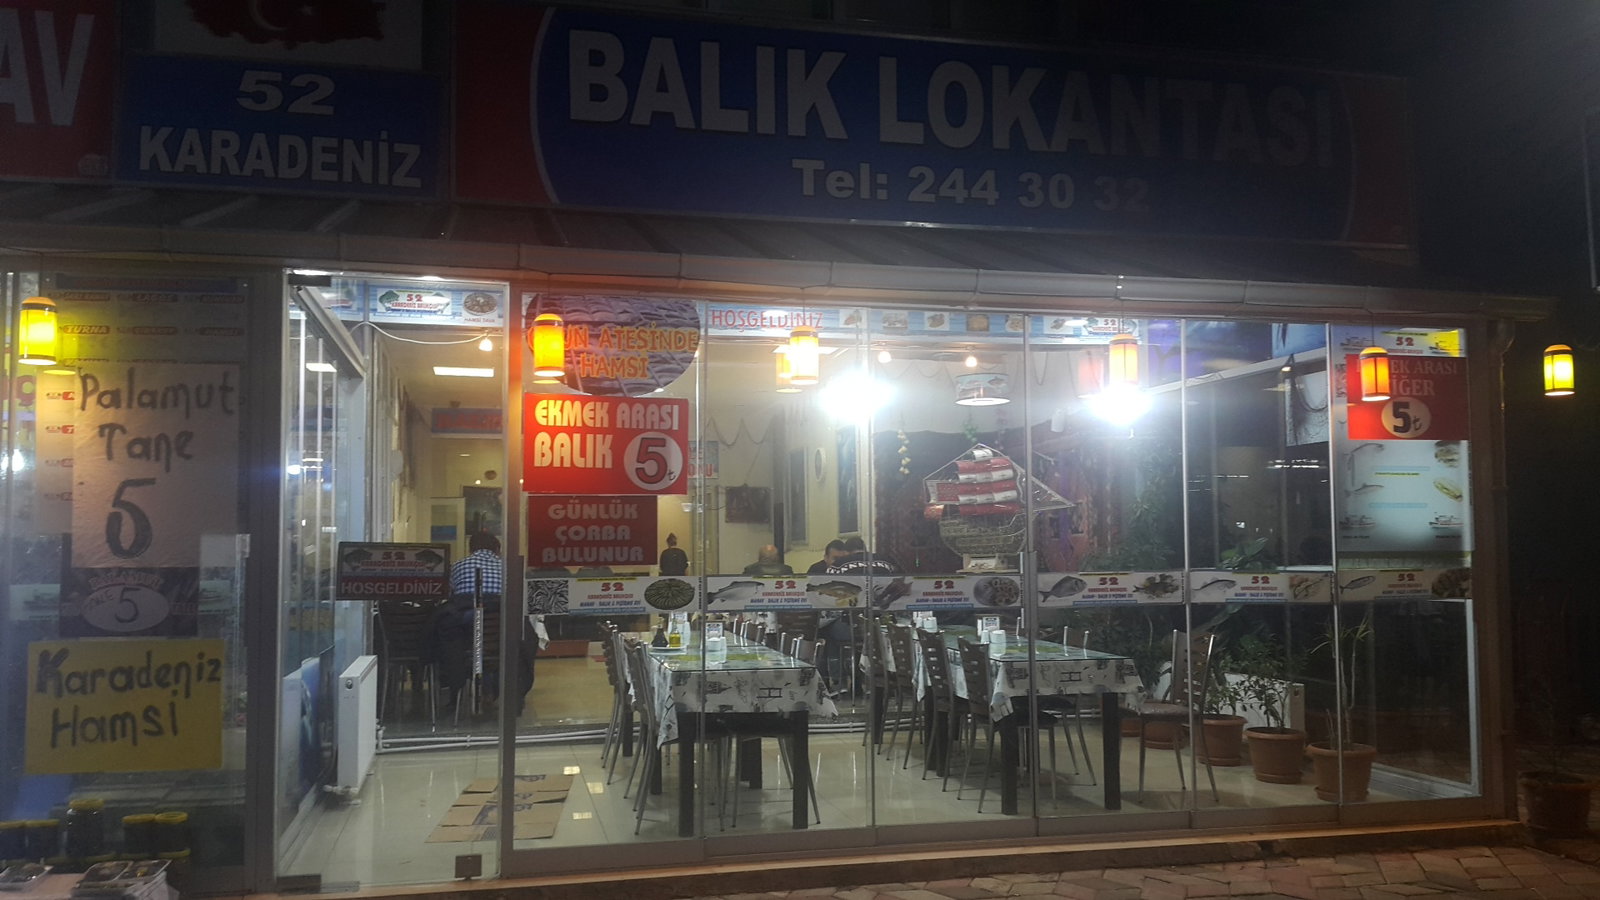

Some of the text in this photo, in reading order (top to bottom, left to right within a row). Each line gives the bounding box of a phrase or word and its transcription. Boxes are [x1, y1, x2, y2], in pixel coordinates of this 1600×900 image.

[236, 69, 337, 116] 52
[568, 29, 1333, 167] BALIK LOKANTASI
[139, 125, 422, 188] KARADENİZ
[792, 158, 1150, 214] Tel: 244 30 32
[406, 293, 424, 303] 52
[1103, 318, 1118, 326] 52
[1395, 336, 1414, 346] 52
[78, 367, 234, 419] Palamut
[1391, 375, 1436, 396] İĞER
[534, 399, 610, 428] EKMEK
[616, 402, 679, 431] ARASI
[97, 422, 194, 473] Tane
[534, 431, 614, 469] BALIK
[547, 499, 638, 520] GÜNLÜK
[555, 525, 631, 545] ÇORBA
[382, 551, 406, 561] 52
[542, 546, 644, 563] BULUNUR
[601, 582, 625, 592] 52
[774, 580, 797, 590] 52
[933, 580, 955, 590] 52
[1098, 577, 1119, 586] 52
[1251, 575, 1271, 585] 52
[1397, 573, 1415, 582] 52
[114, 587, 142, 624] 5
[36, 648, 222, 699] Karadeniz
[50, 689, 179, 748] Hamsi
